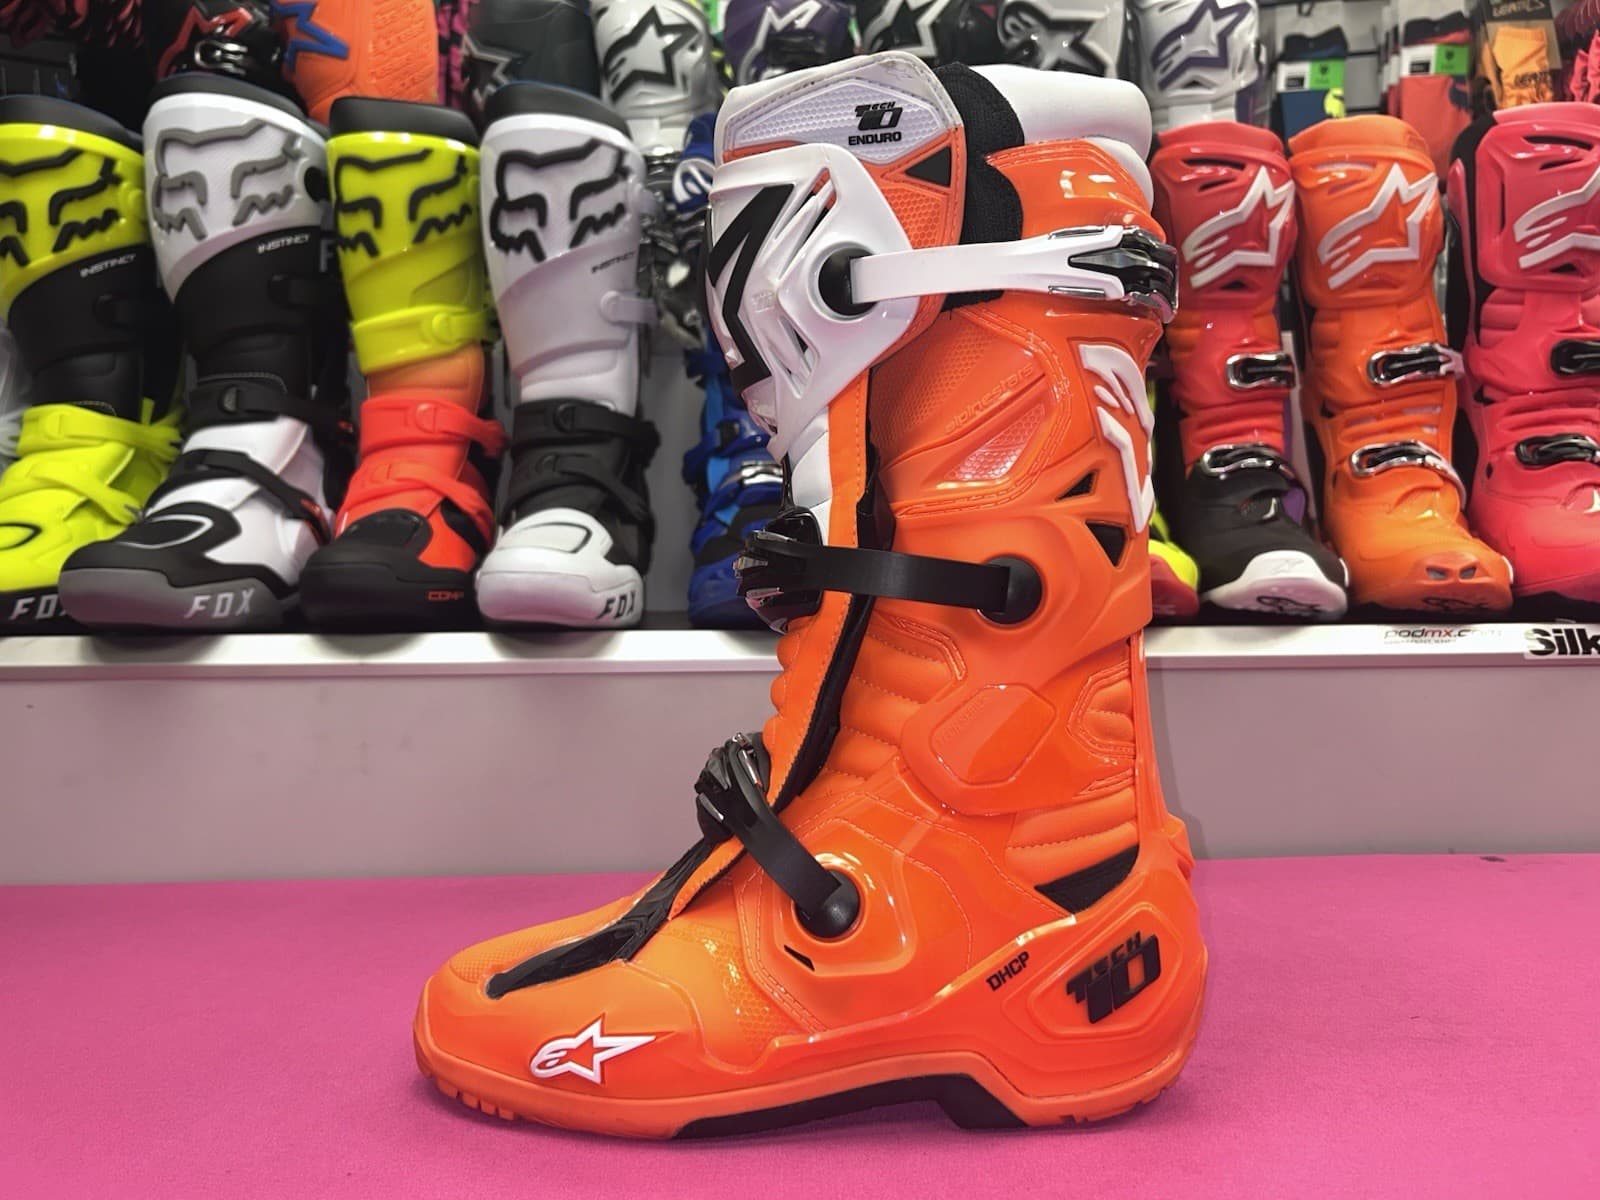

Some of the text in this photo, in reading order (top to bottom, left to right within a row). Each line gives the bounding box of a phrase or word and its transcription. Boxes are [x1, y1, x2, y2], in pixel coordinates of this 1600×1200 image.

[854, 101, 896, 118] TECH
[848, 131, 902, 146] ENDURO
[9, 594, 68, 621] FO
[184, 588, 255, 619] FOX
[594, 590, 636, 620] FOX
[1524, 627, 1600, 656] Silk
[985, 950, 1030, 992] DHCP
[1066, 930, 1142, 1005] TECH
